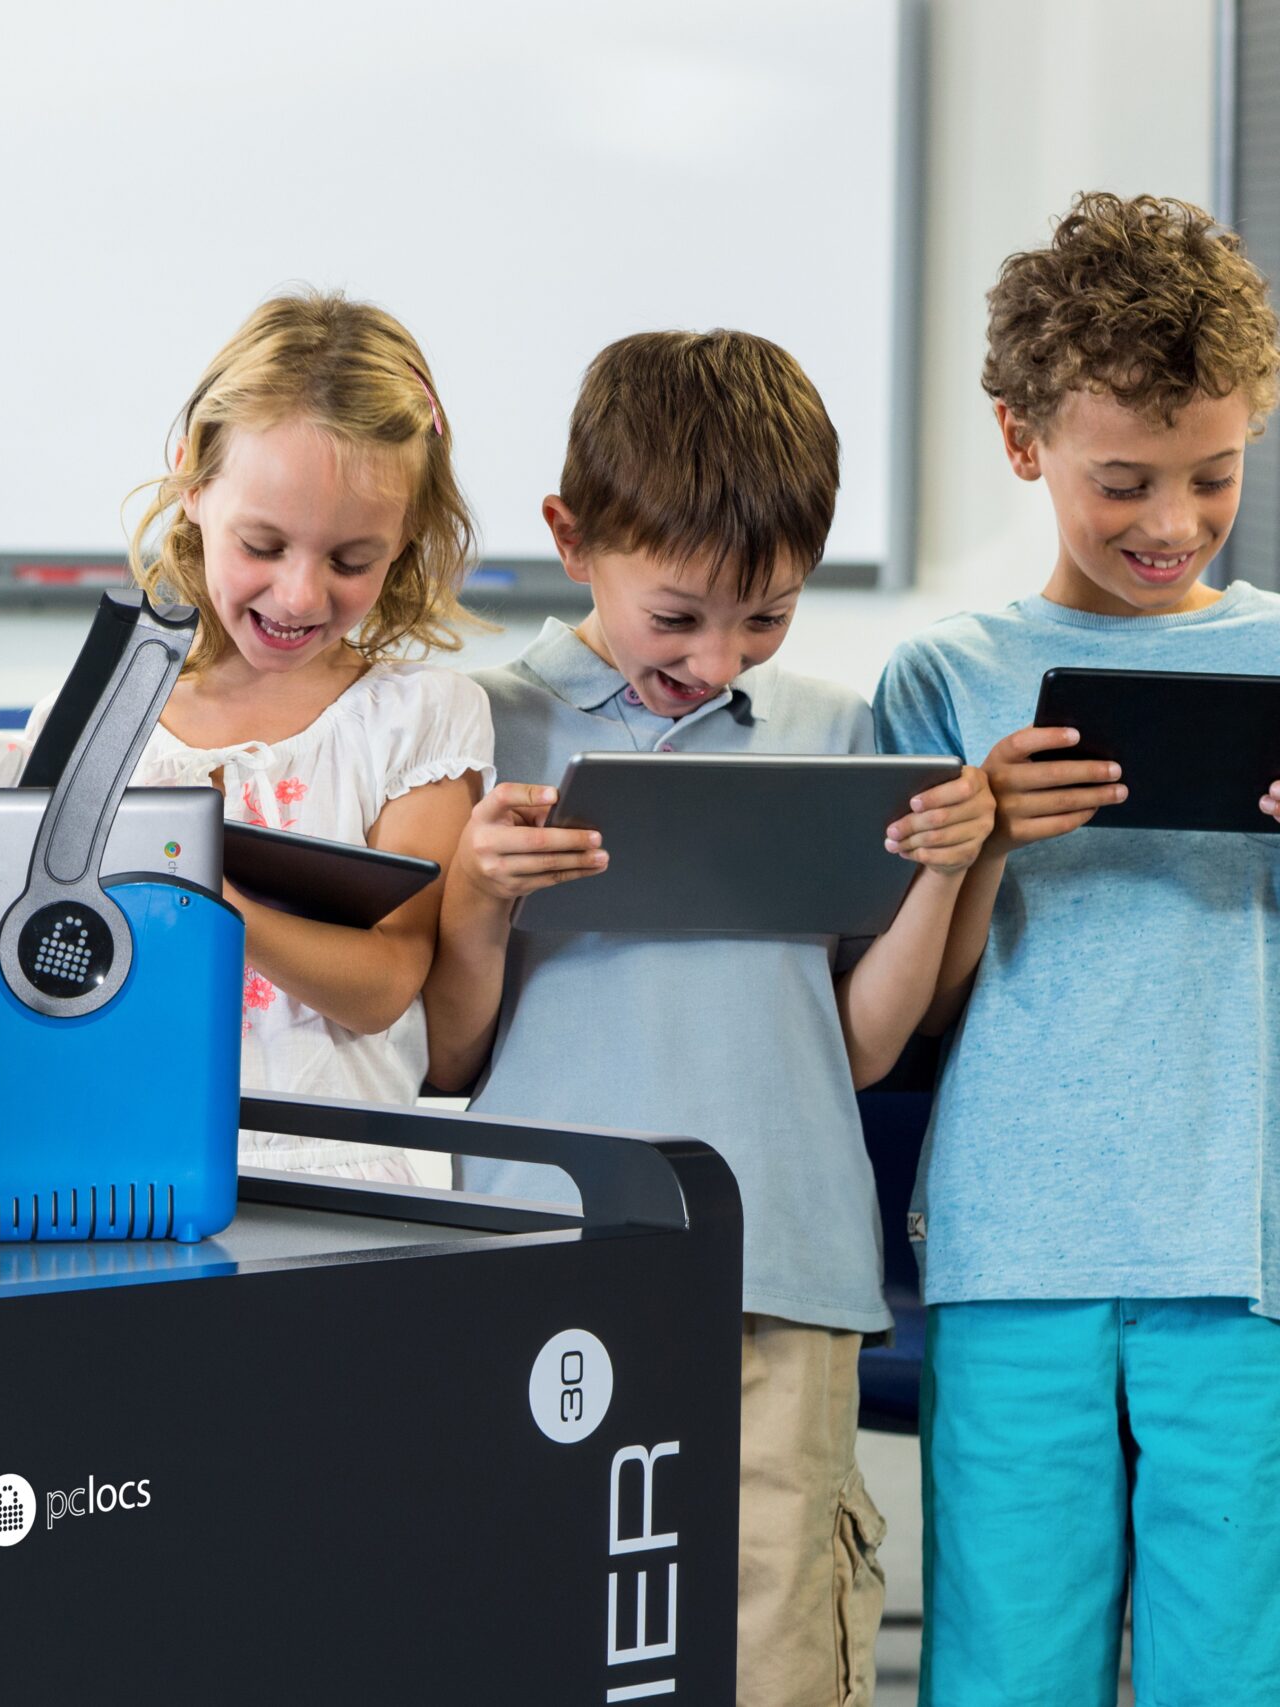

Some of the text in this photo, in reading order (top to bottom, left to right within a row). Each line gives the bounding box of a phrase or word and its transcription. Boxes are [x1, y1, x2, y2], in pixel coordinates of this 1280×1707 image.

[560, 1350, 584, 1422] 30
[46, 1474, 151, 1530] pclocs
[606, 1440, 680, 1704] IER
